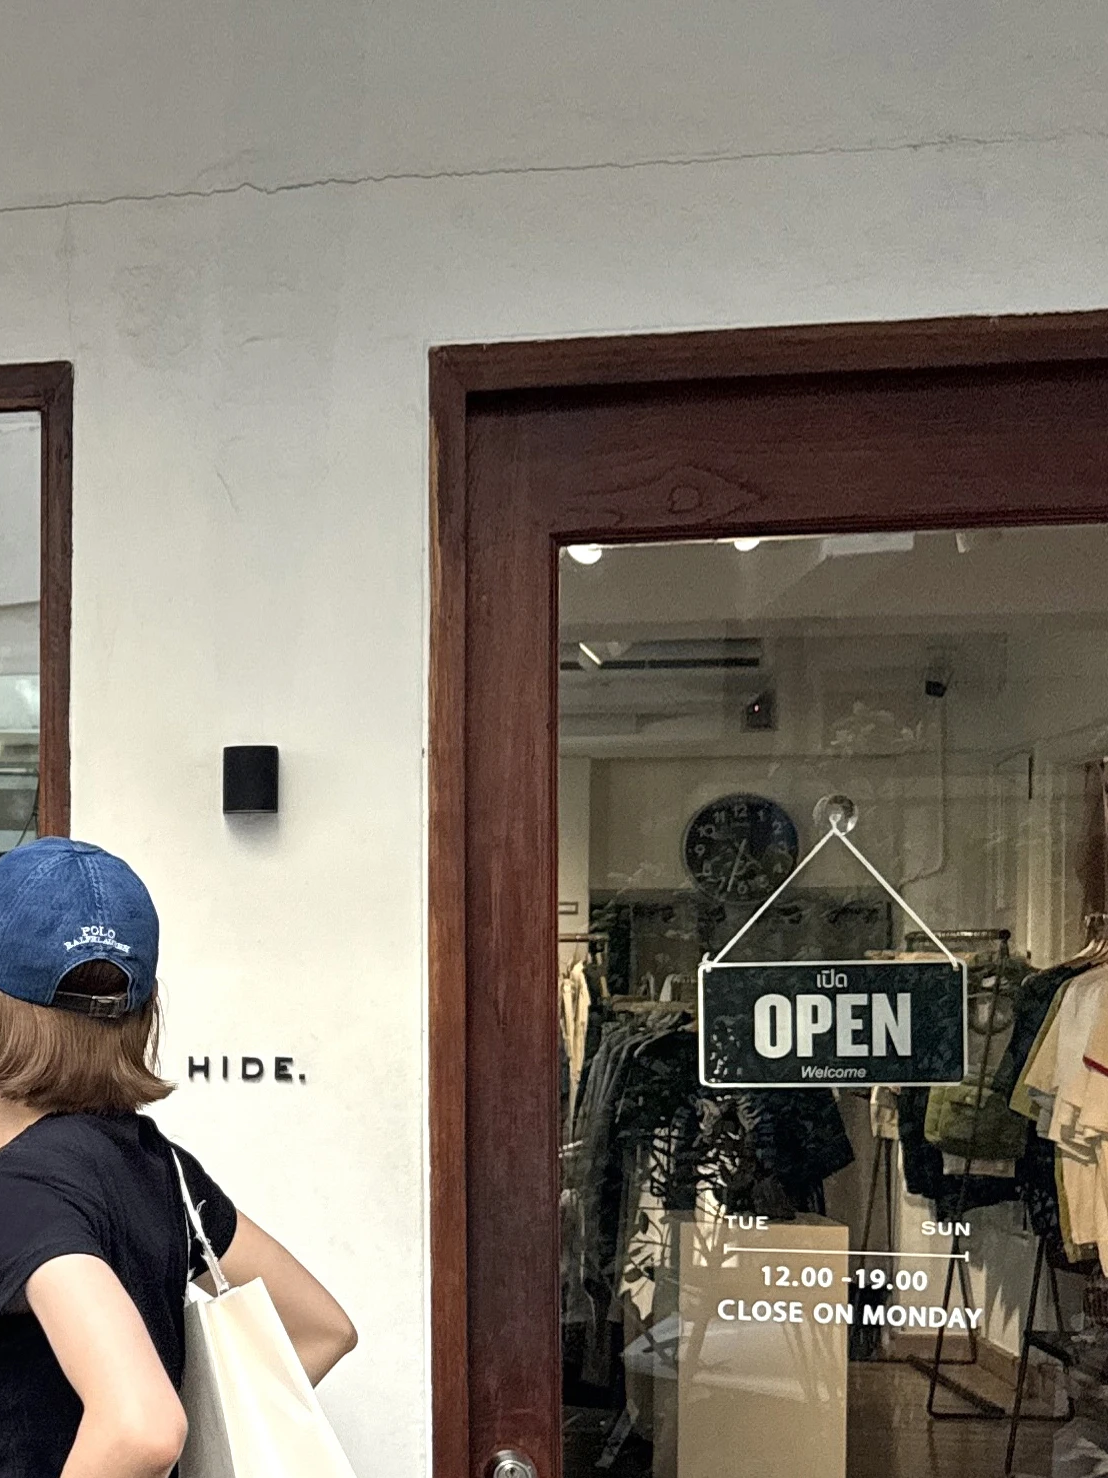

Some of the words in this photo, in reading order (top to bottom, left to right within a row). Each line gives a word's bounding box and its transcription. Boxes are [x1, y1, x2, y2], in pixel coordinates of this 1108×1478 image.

[81, 925, 116, 939] POLO
[754, 993, 912, 1058] OPEN
[188, 1056, 306, 1080] HIDE.
[801, 1066, 866, 1078] Welcome
[725, 1215, 768, 1230] TUE
[921, 1221, 970, 1236] SUN
[761, 1266, 833, 1287] 12.00
[717, 1300, 803, 1323] CLOSE
[813, 1303, 854, 1325] ON
[862, 1305, 983, 1329] MONDAY
